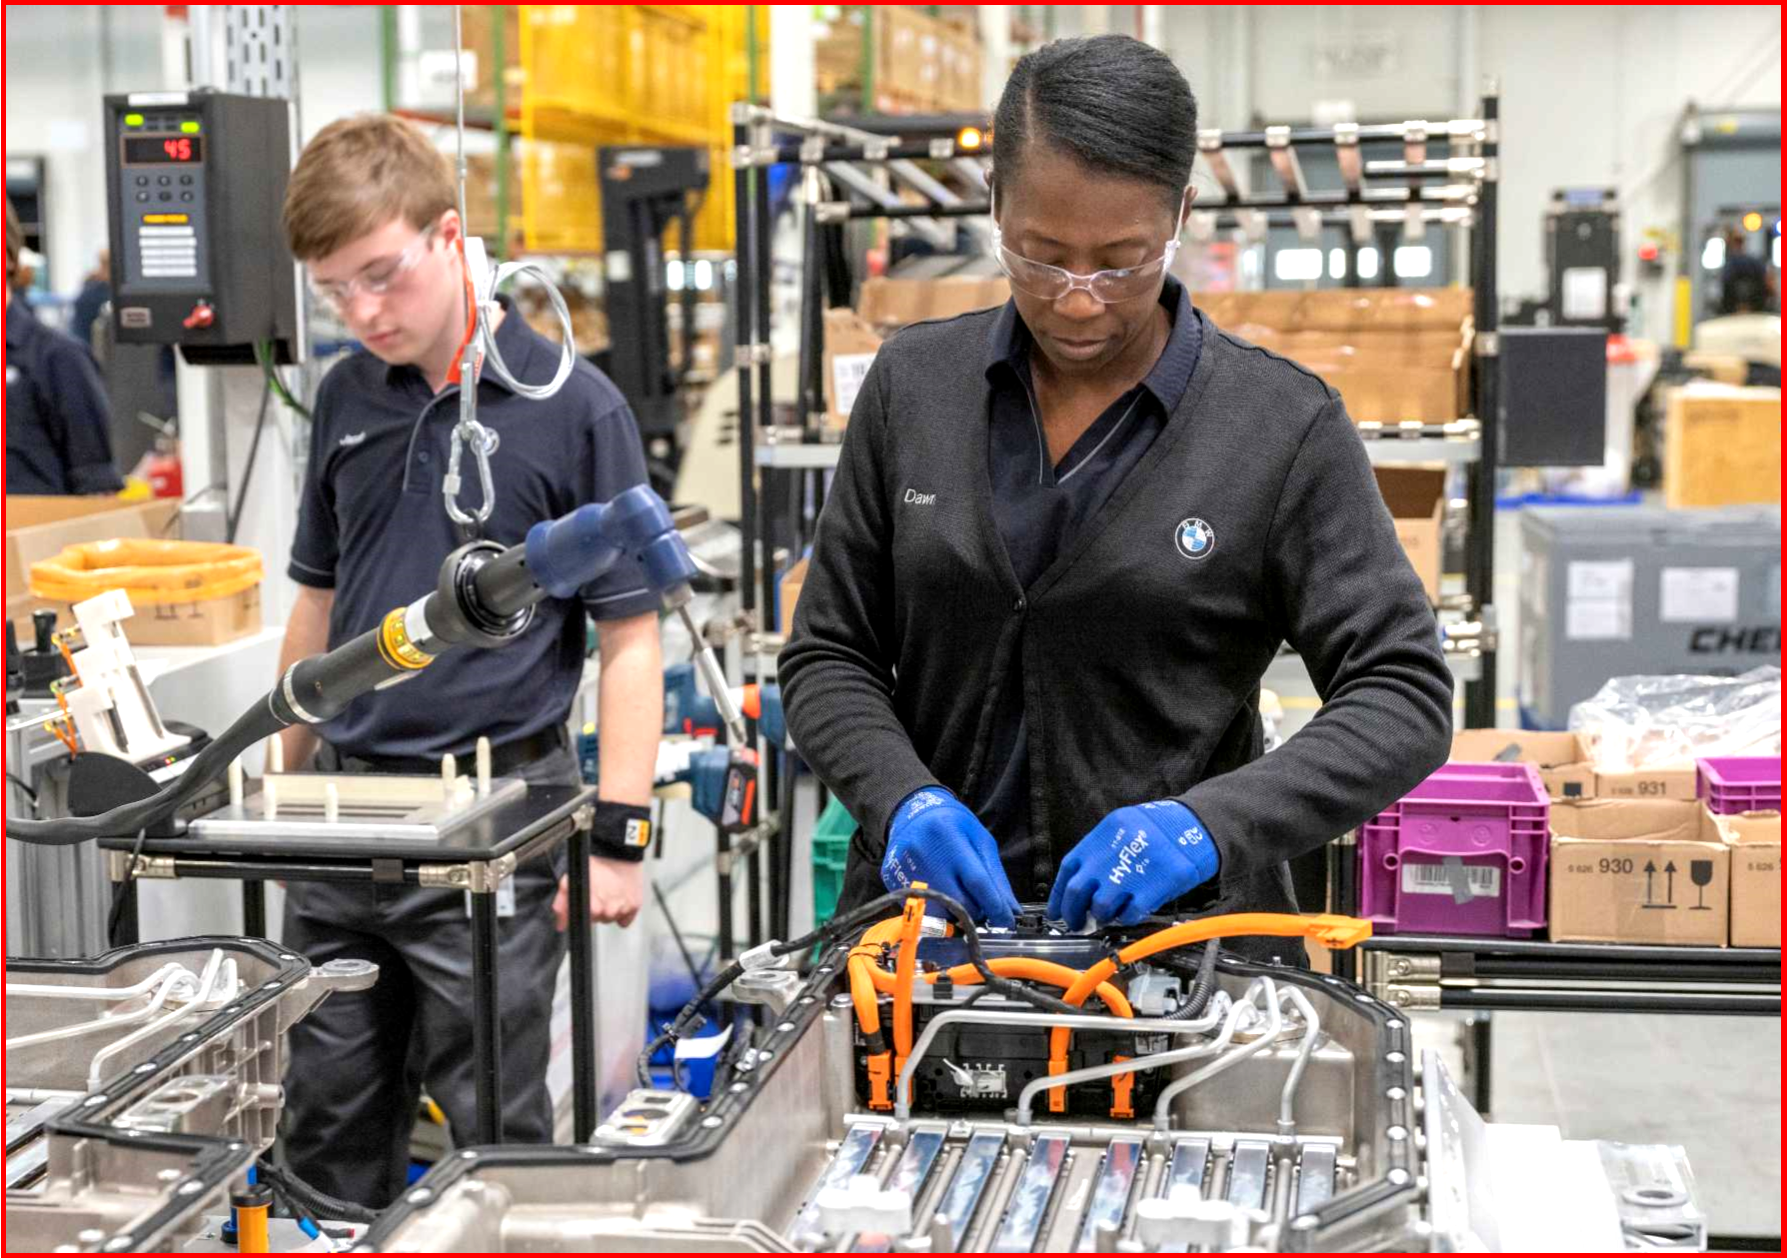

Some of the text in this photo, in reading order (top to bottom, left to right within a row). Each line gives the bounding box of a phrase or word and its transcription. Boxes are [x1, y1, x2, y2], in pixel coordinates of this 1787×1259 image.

[163, 138, 192, 161] 45
[1638, 781, 1666, 795] 931
[1599, 858, 1634, 874] 930
